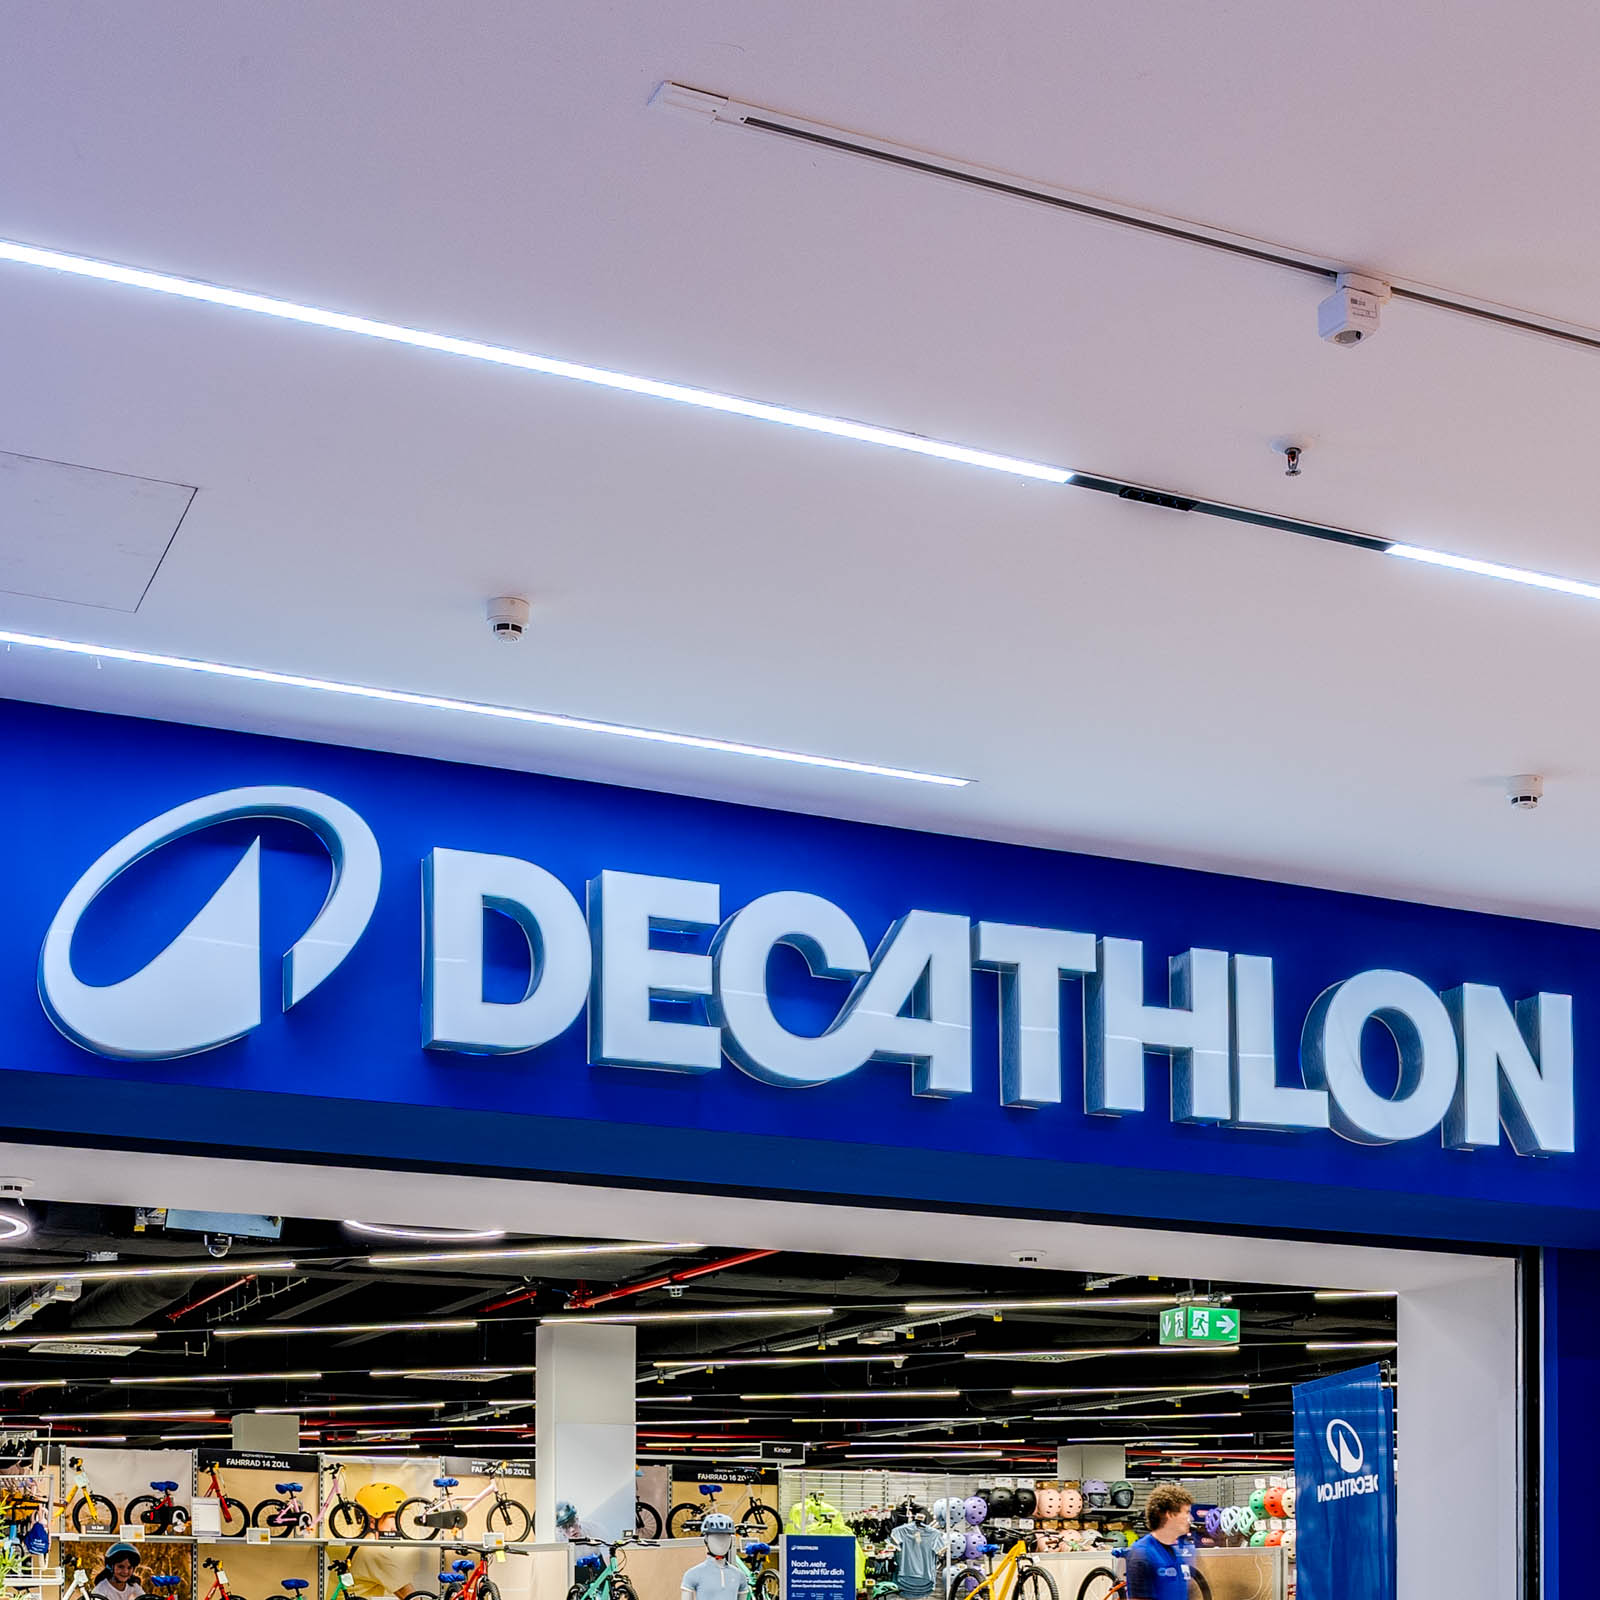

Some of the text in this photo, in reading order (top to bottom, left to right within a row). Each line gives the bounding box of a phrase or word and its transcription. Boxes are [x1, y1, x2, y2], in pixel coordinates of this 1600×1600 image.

[421, 845, 1576, 1158] DECATHLON
[773, 1446, 793, 1454] Kinder
[226, 1458, 291, 1469] FAHRRAD 14 ZOLL
[513, 1468, 531, 1477] ZOLL
[697, 1472, 729, 1481] FAHRRAD
[791, 1560, 809, 1568] Noch
[791, 1568, 845, 1576] Auswahl für dich
